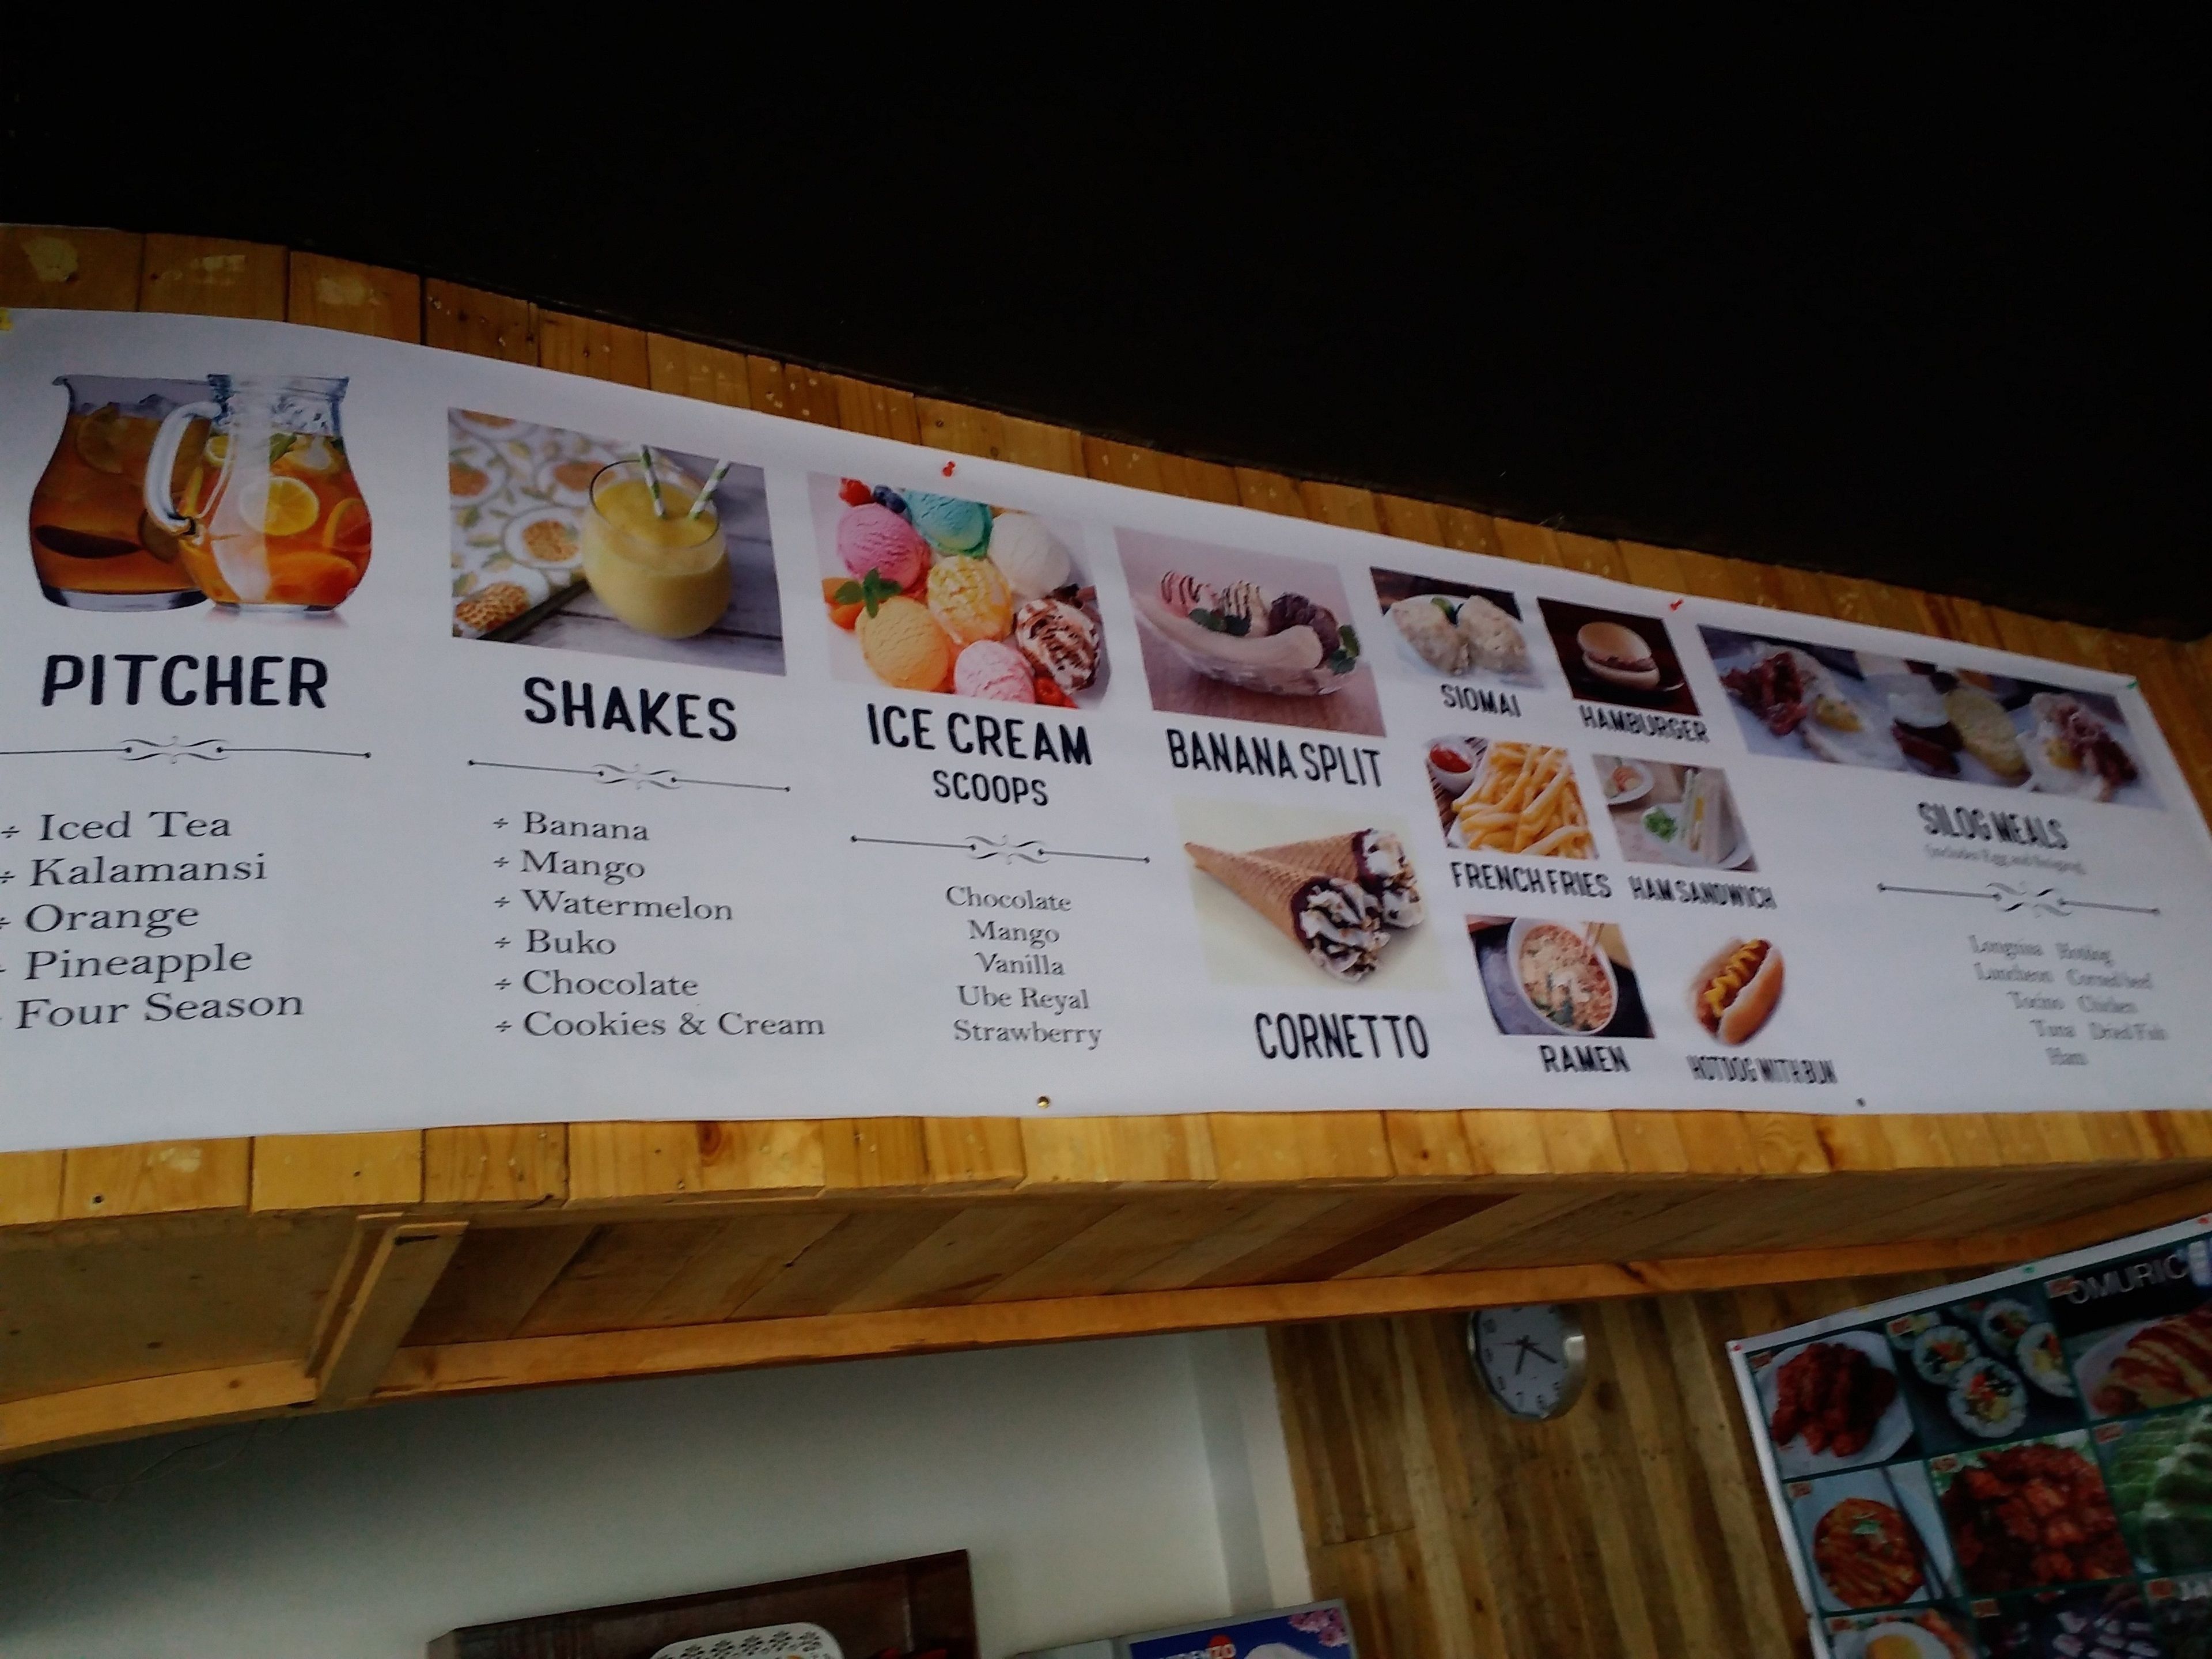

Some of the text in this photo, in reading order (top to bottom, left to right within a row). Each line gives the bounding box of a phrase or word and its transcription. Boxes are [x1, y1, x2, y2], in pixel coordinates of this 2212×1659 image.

[41, 654, 328, 709] PITCHER
[523, 676, 738, 742] SHAKES
[1441, 684, 1522, 717] SIOMAI
[867, 703, 1093, 766] ICE CREAM
[1579, 704, 1709, 743] HAMBURGER
[1166, 728, 1381, 787] BANANA SPLIT
[933, 770, 1048, 806] SCOOPS
[39, 810, 231, 840] Iced Tea
[524, 811, 649, 840] Banana
[29, 853, 266, 887] Kalamansi
[521, 850, 645, 885] Mango
[1450, 862, 1612, 898] FRENCH FRIES
[520, 889, 732, 920] Watermelon
[946, 886, 1071, 911] Chocolate
[25, 904, 199, 938] Orange
[968, 919, 1059, 949] Mango
[526, 929, 616, 955] Buko
[25, 943, 252, 984] Pineapple
[974, 952, 1065, 975] Vanilla
[522, 969, 698, 996] Chocolate
[957, 985, 1012, 1007] Ube
[16, 993, 303, 1029] Four Season
[523, 1011, 825, 1036] Cookies & Cream
[953, 1020, 1101, 1051] Strawberry
[1255, 1013, 1429, 1059] CORNETTO
[1539, 1045, 1631, 1072] RAMEN
